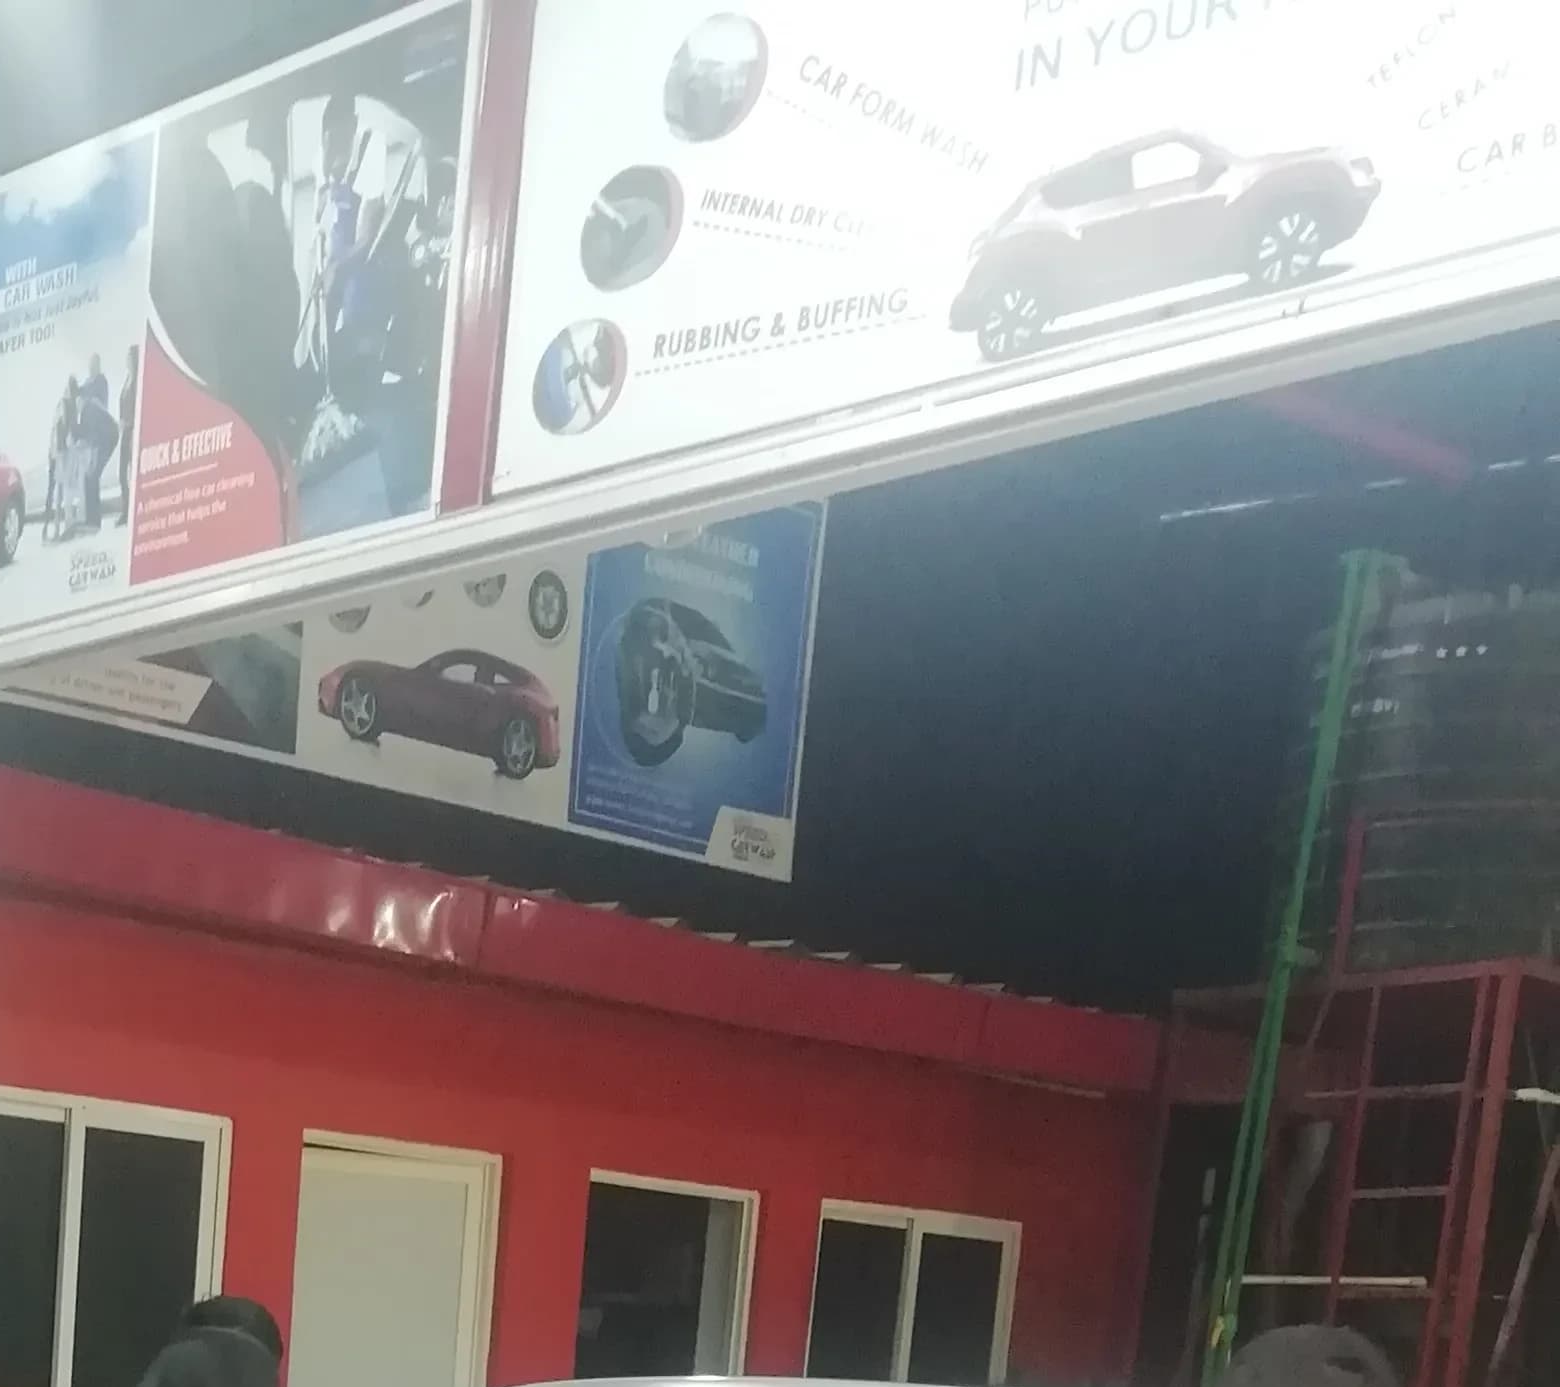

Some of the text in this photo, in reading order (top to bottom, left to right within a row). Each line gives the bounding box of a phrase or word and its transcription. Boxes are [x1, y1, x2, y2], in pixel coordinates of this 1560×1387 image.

[1015, 36, 1062, 91] IN
[799, 54, 989, 174] CAR FORM WASH
[1457, 132, 1526, 173] CAR
[700, 188, 784, 224] INTERNAL
[790, 204, 829, 229] DRY
[35, 267, 75, 298] WASH
[653, 287, 909, 359] RUBBING & BUFFING
[140, 442, 171, 475] QUICK
[182, 421, 234, 463] EFFECTIVE
